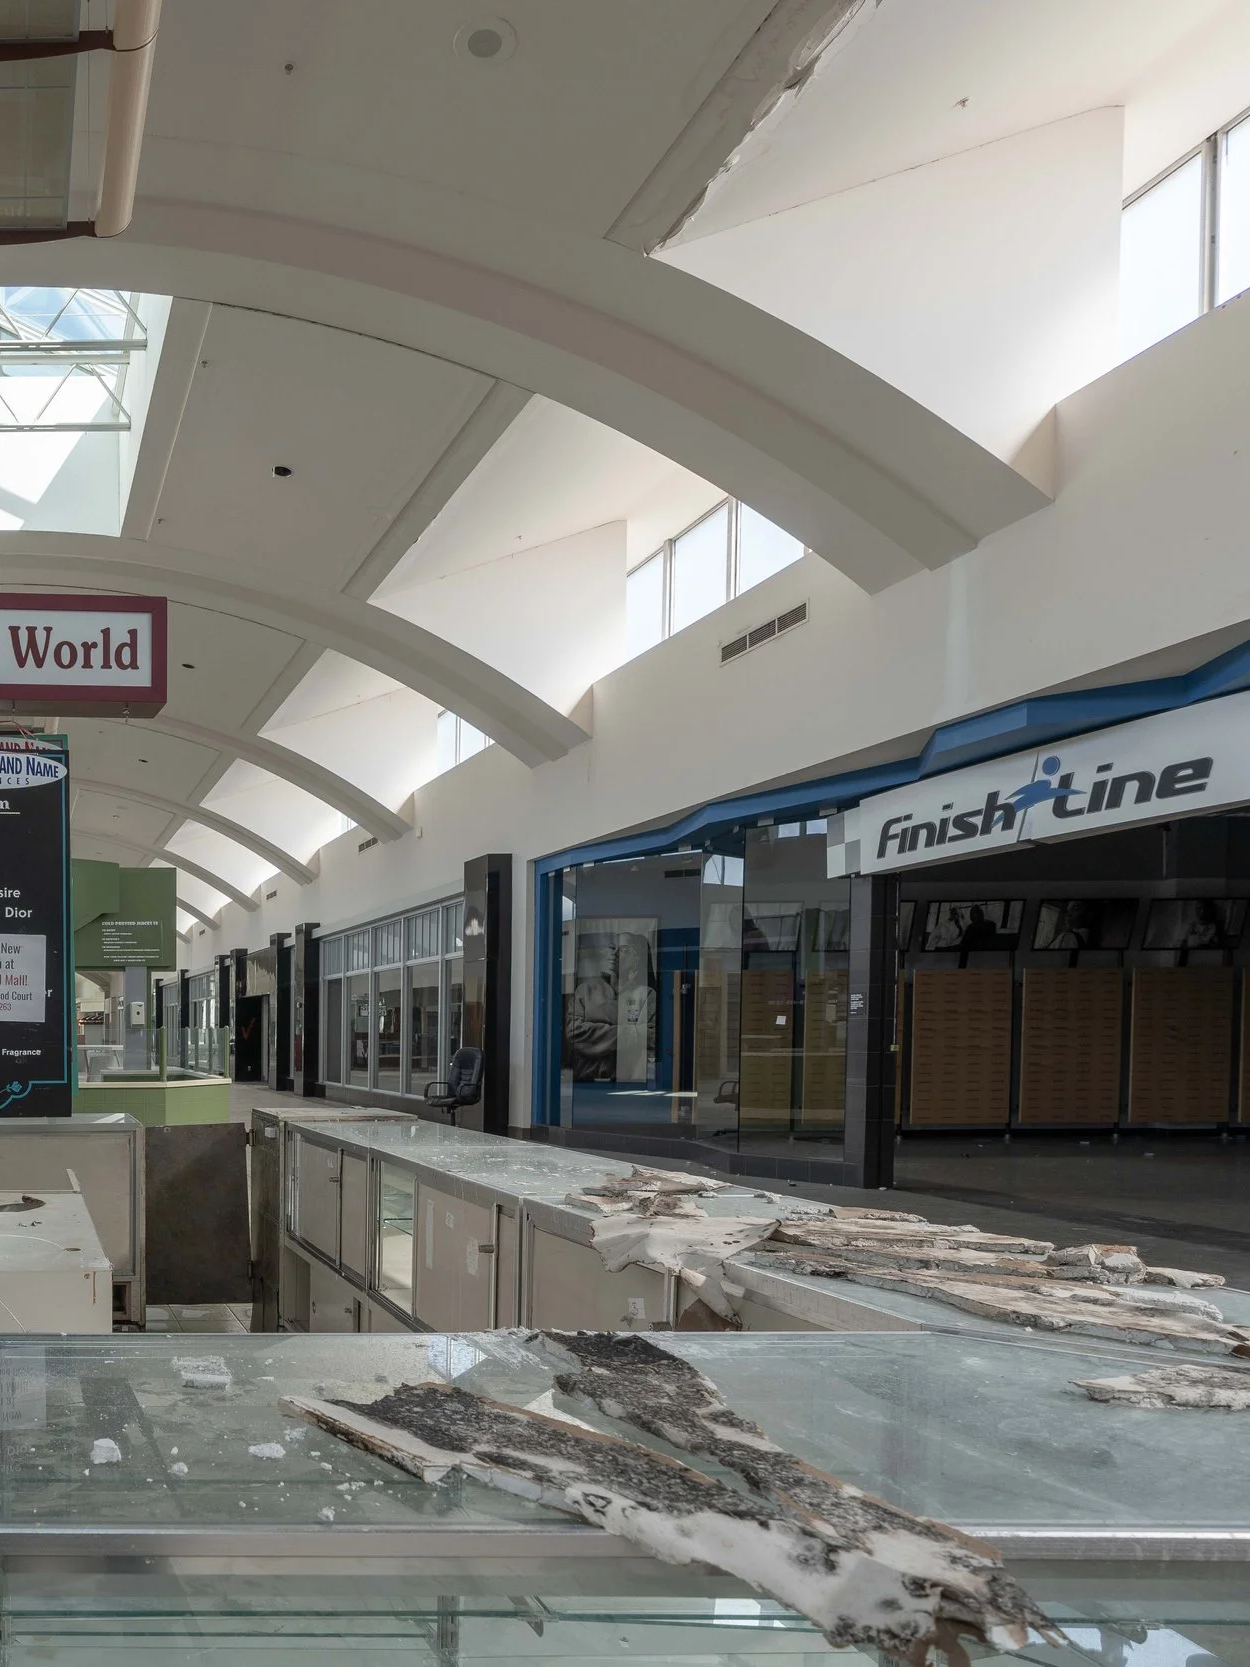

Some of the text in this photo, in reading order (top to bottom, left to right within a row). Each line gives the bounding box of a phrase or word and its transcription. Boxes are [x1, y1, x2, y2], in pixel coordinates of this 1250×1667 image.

[8, 625, 139, 670] World
[26, 756, 59, 778] NAME
[5, 907, 32, 918] Dior
[1, 942, 21, 954] New
[5, 958, 15, 969] at
[5, 974, 28, 986] Mall!
[11, 991, 33, 1001] Court
